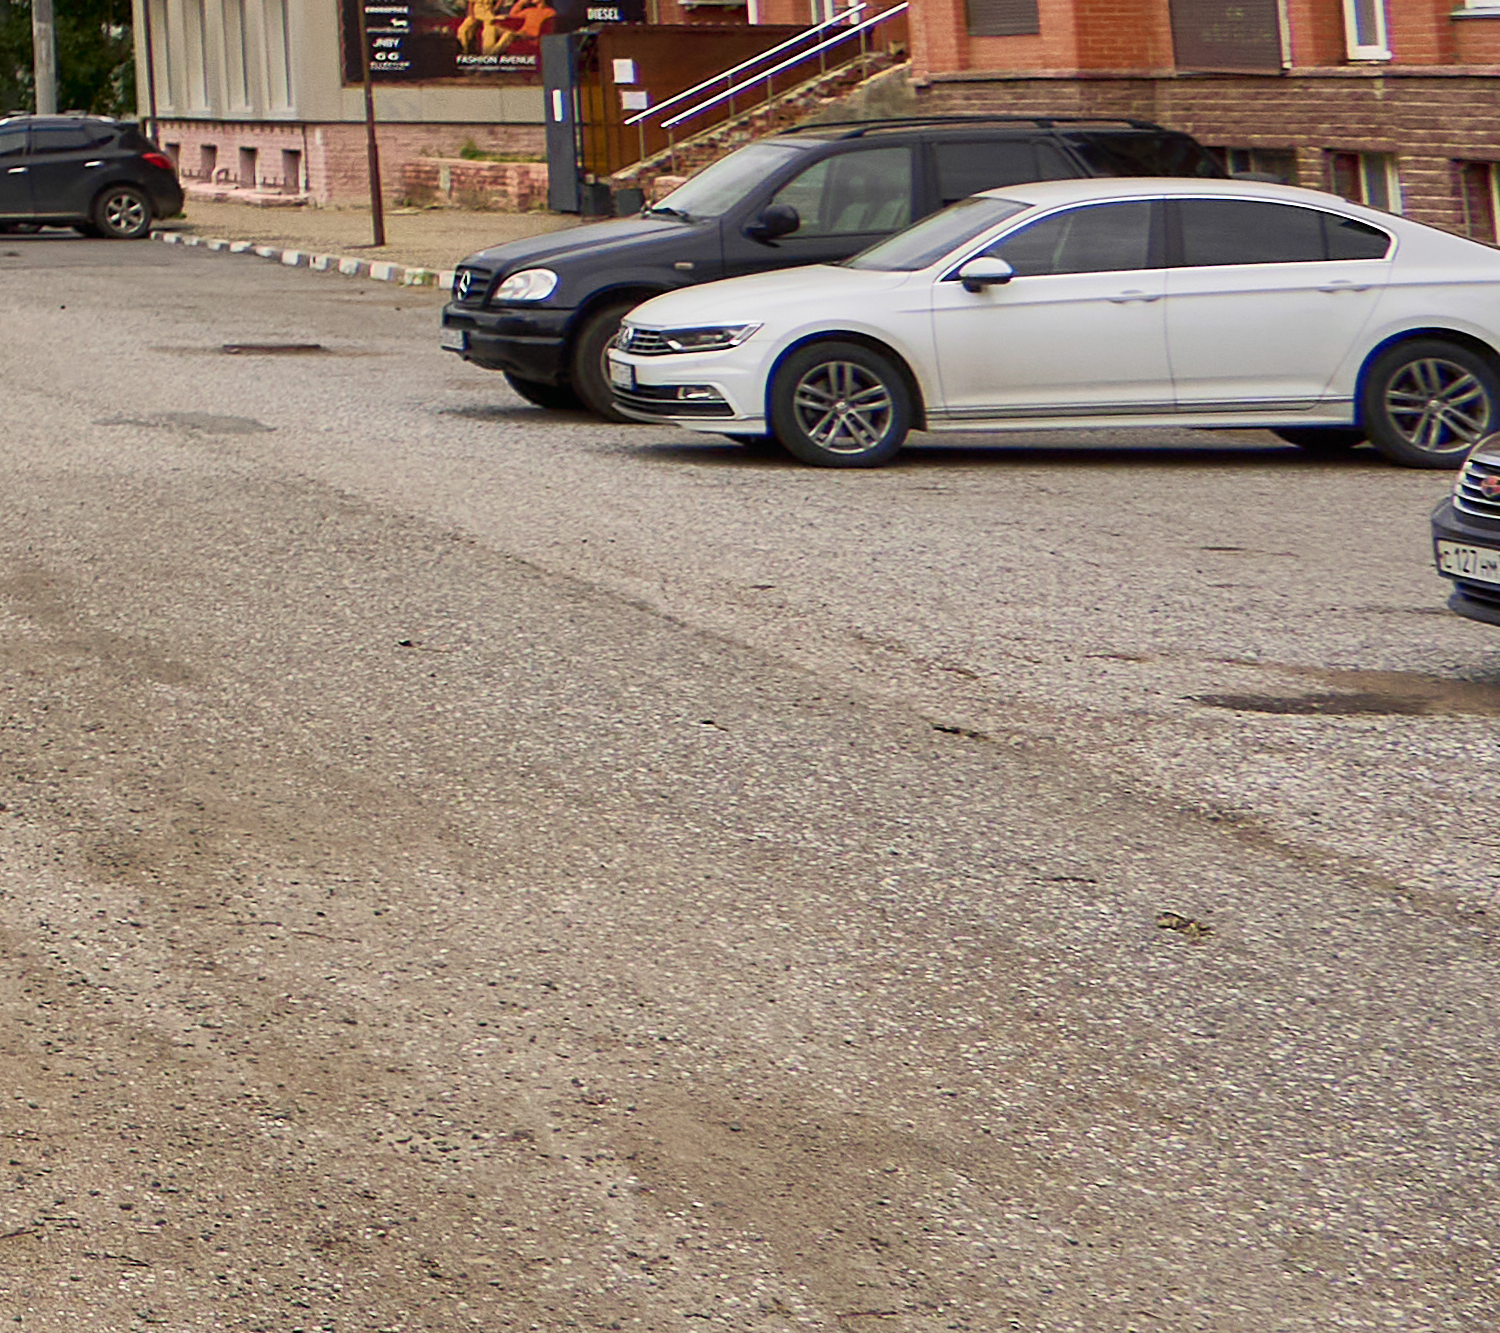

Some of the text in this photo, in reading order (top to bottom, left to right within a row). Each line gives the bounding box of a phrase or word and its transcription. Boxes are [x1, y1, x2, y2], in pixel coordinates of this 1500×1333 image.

[587, 7, 620, 20] DIESEL
[456, 55, 537, 66] FASHION AVENUE
